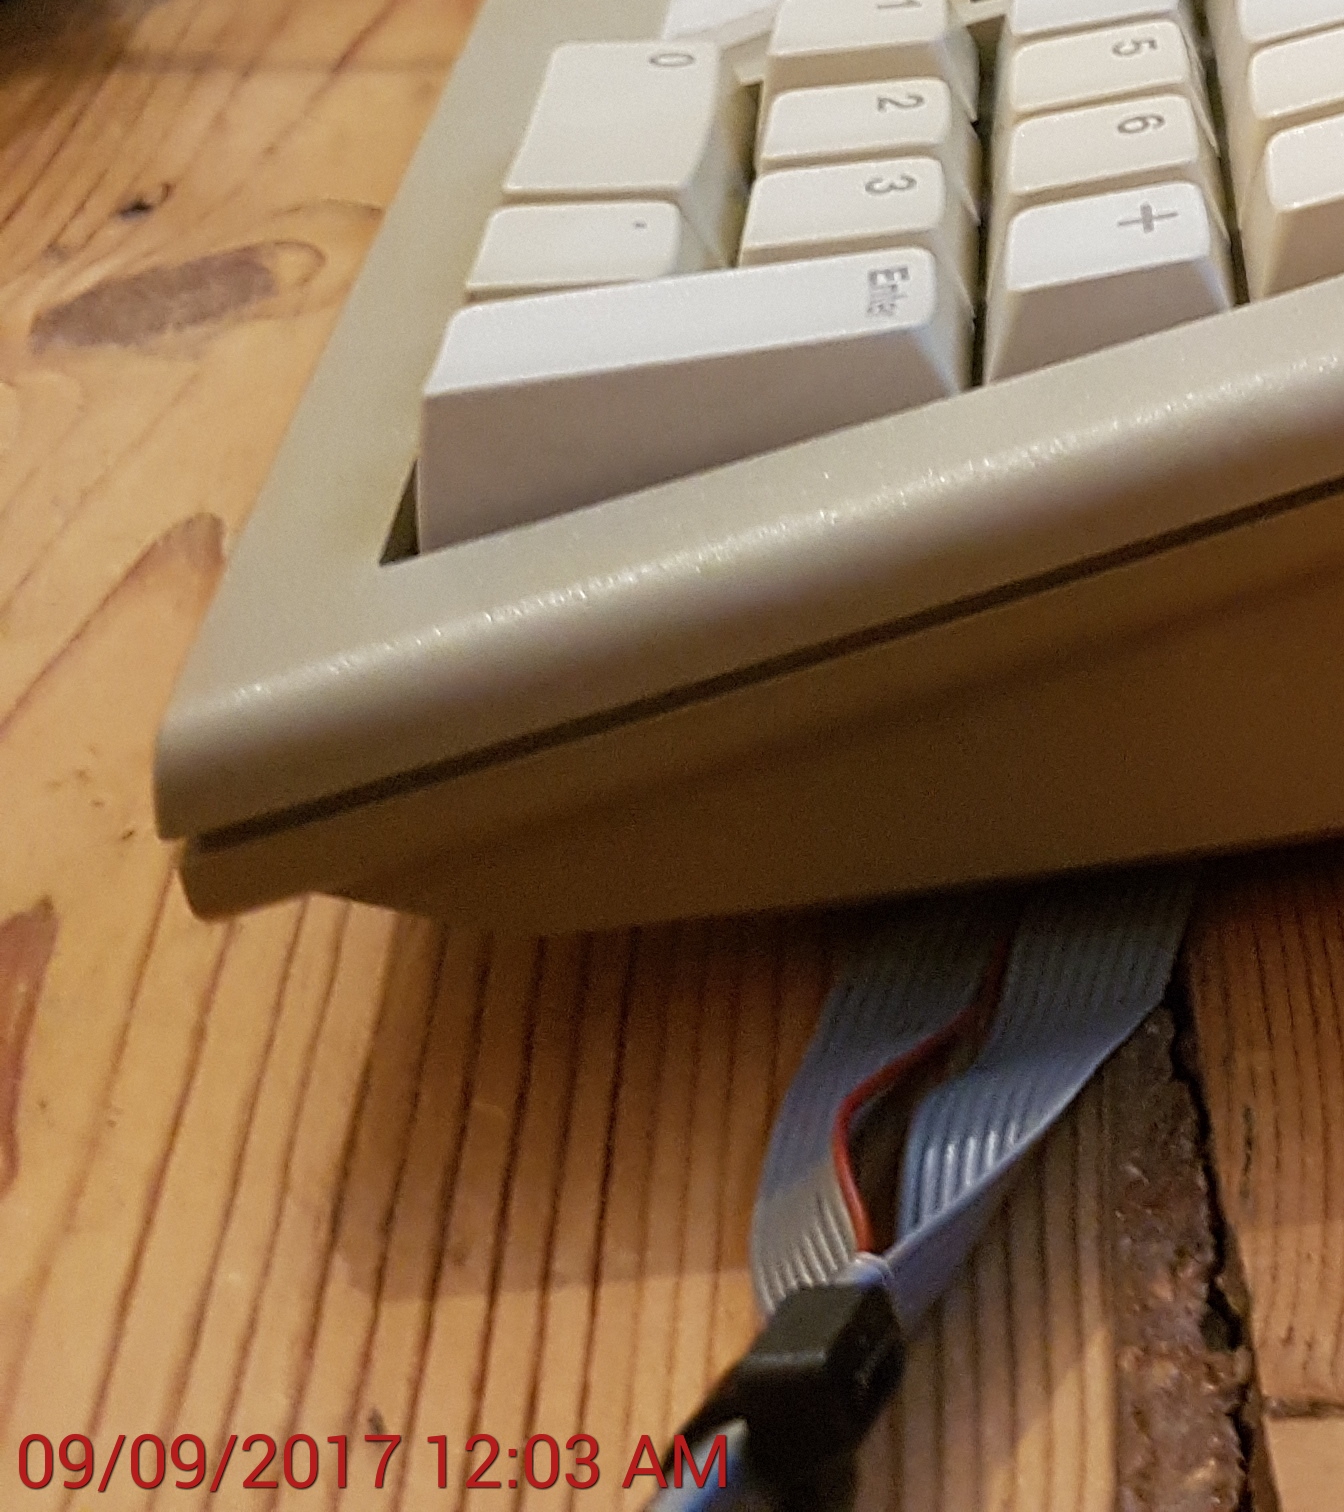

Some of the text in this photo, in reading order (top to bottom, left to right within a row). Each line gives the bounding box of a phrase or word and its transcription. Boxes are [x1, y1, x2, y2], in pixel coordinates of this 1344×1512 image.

[1111, 37, 1159, 59] 5
[647, 51, 696, 69] 0
[876, 93, 925, 114] 2
[1115, 113, 1166, 136] 6
[863, 174, 918, 196] 3
